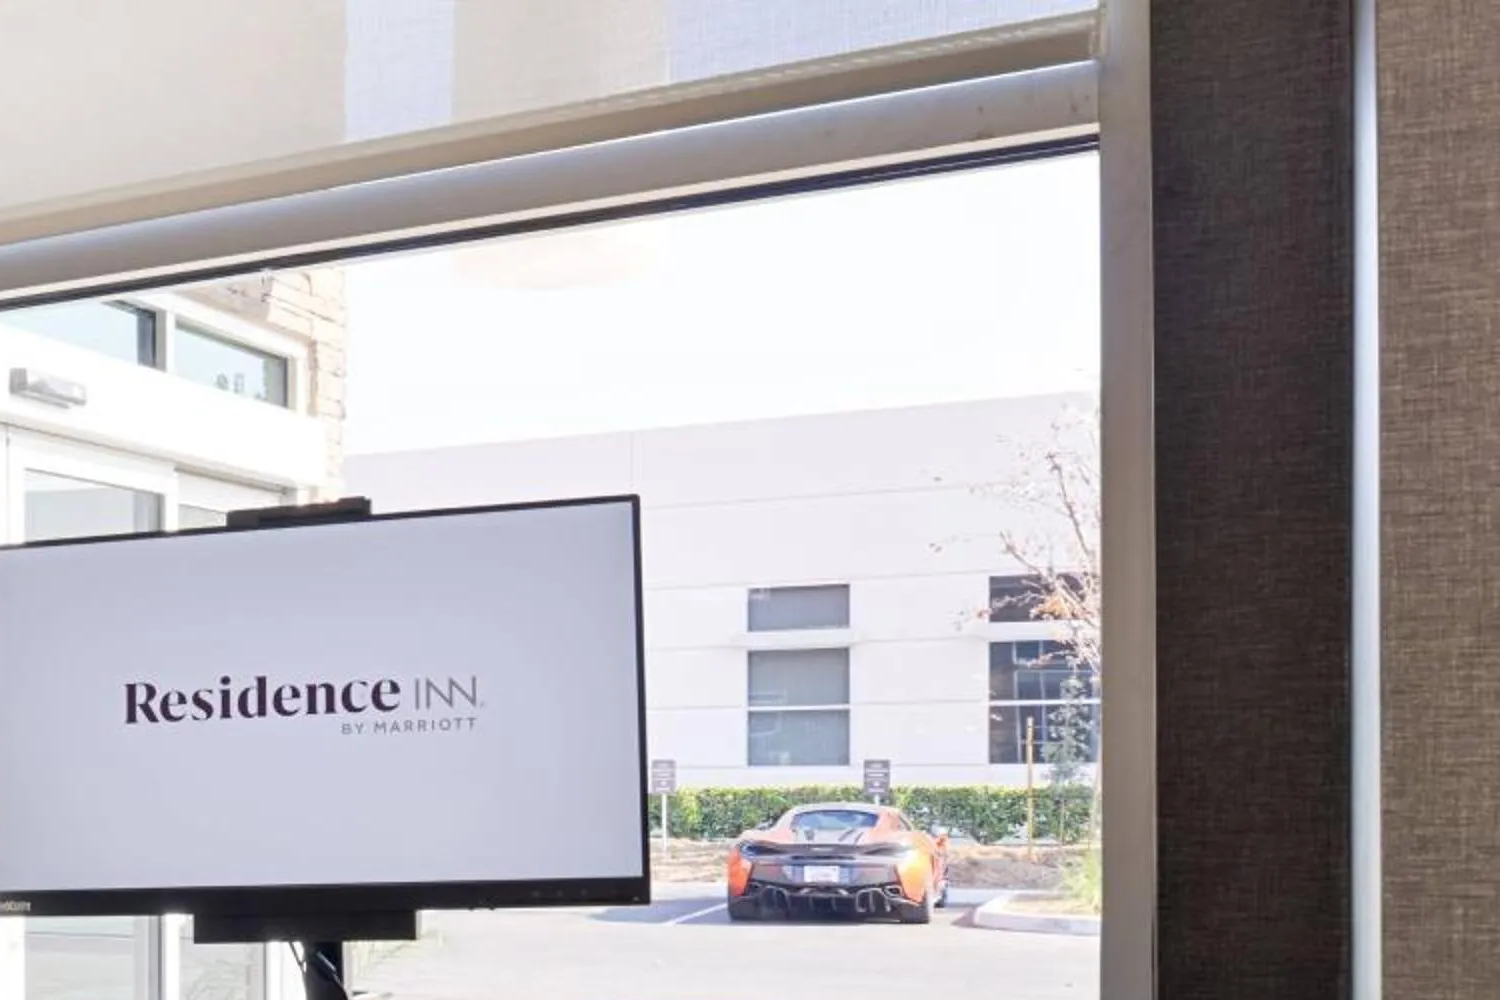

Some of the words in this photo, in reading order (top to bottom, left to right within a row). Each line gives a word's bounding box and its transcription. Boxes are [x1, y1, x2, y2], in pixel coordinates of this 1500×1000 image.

[124, 675, 401, 725] Residence
[414, 675, 478, 711] INN
[341, 721, 365, 735] BY
[373, 717, 478, 734] MARRIOTT
